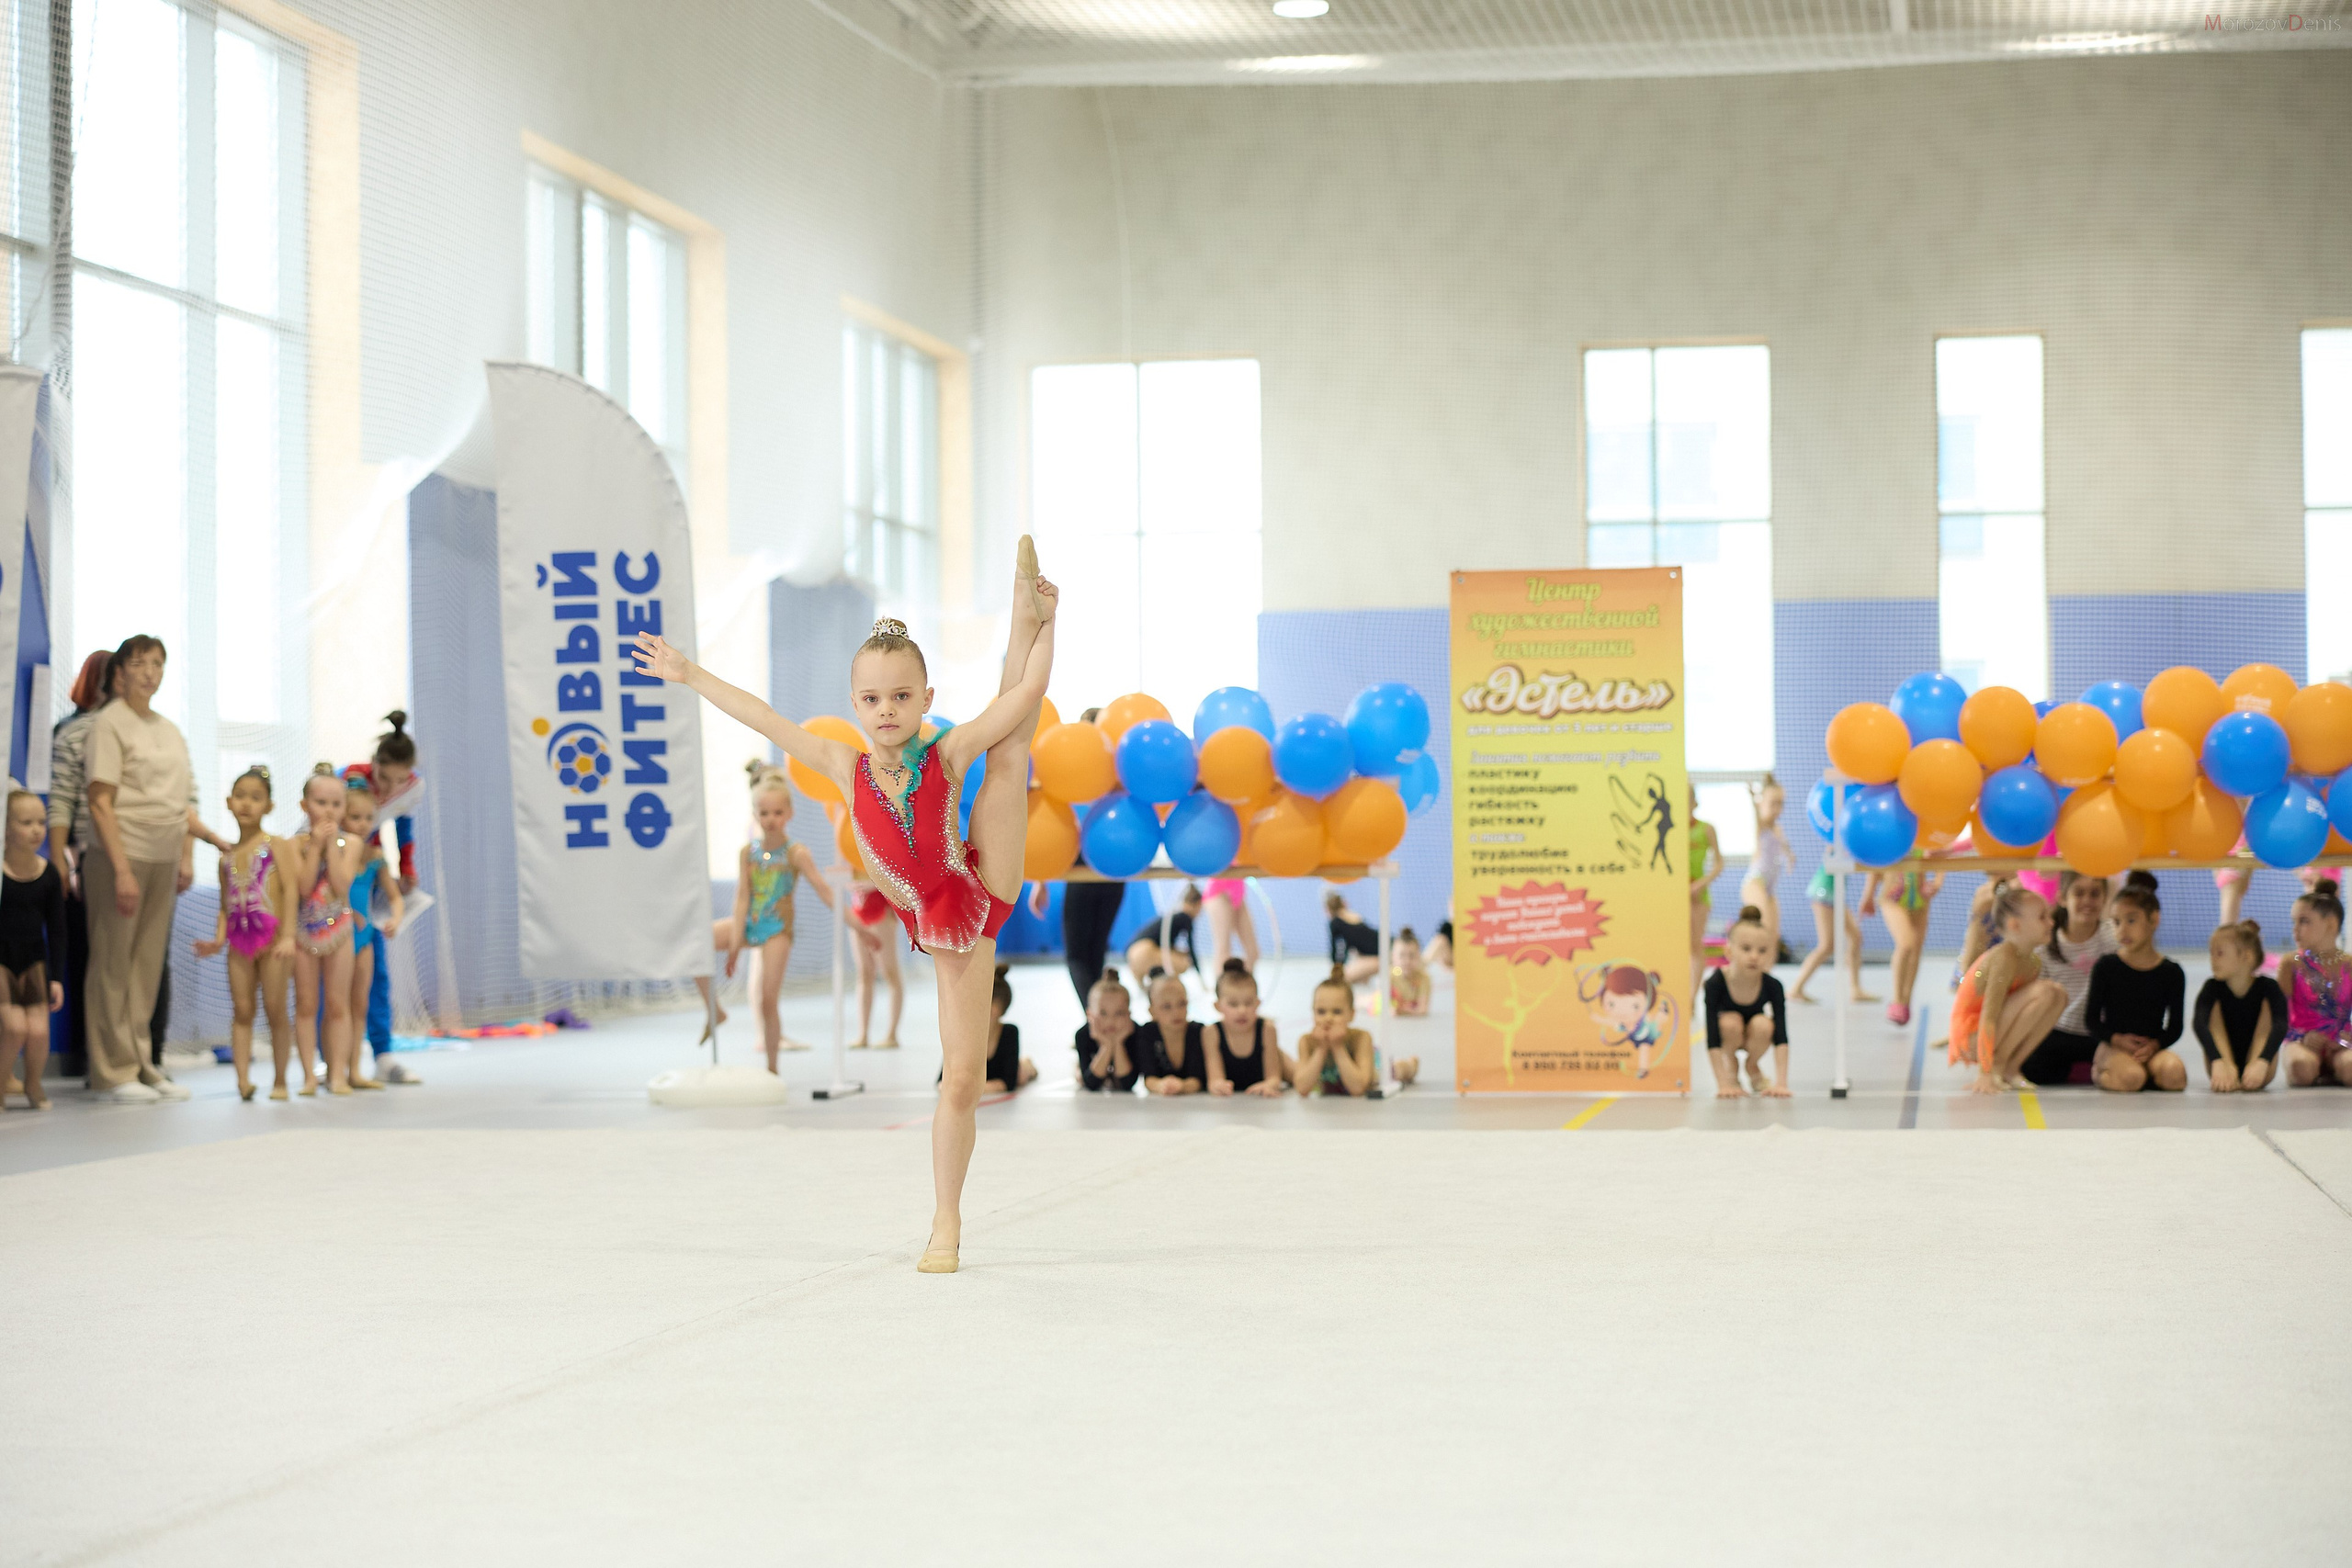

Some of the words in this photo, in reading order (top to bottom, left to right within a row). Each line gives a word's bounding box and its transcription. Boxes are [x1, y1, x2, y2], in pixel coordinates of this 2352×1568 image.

[1525, 577, 1602, 606] Центр
[1467, 604, 1659, 640] художественной
[1494, 639, 1634, 659] гимнастики
[1461, 664, 1674, 718] «Эстель»
[613, 551, 673, 849] ФИТНЕС
[1468, 769, 1540, 780] пластику
[1469, 784, 1578, 795] координацию
[1469, 798, 1539, 809] гибкость
[1468, 815, 1545, 828] растяжку
[1472, 847, 1569, 860] трудолюбие
[1472, 863, 1570, 876] уверенность
[1590, 862, 1626, 874] себе
